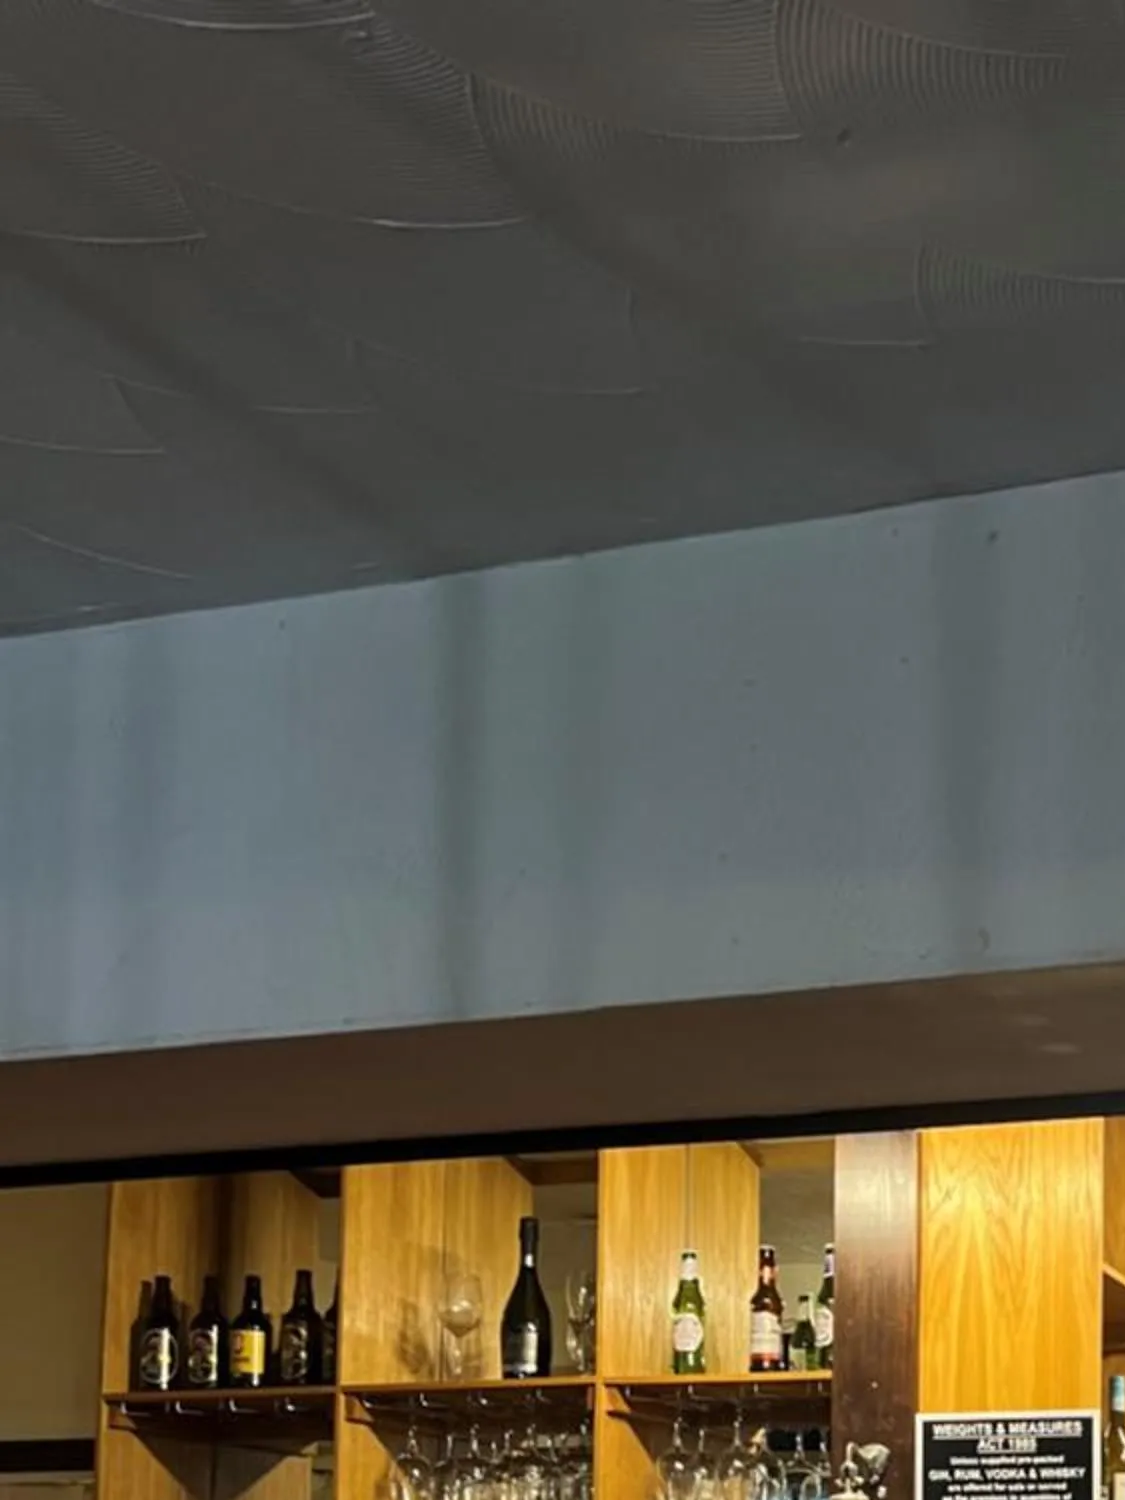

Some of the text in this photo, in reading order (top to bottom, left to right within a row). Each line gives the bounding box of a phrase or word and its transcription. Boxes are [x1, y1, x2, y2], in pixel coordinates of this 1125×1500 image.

[932, 1420, 1083, 1437] WEIGHTS & MEASURES
[984, 1468, 1027, 1480] VODKA
[1029, 1467, 1038, 1480] &
